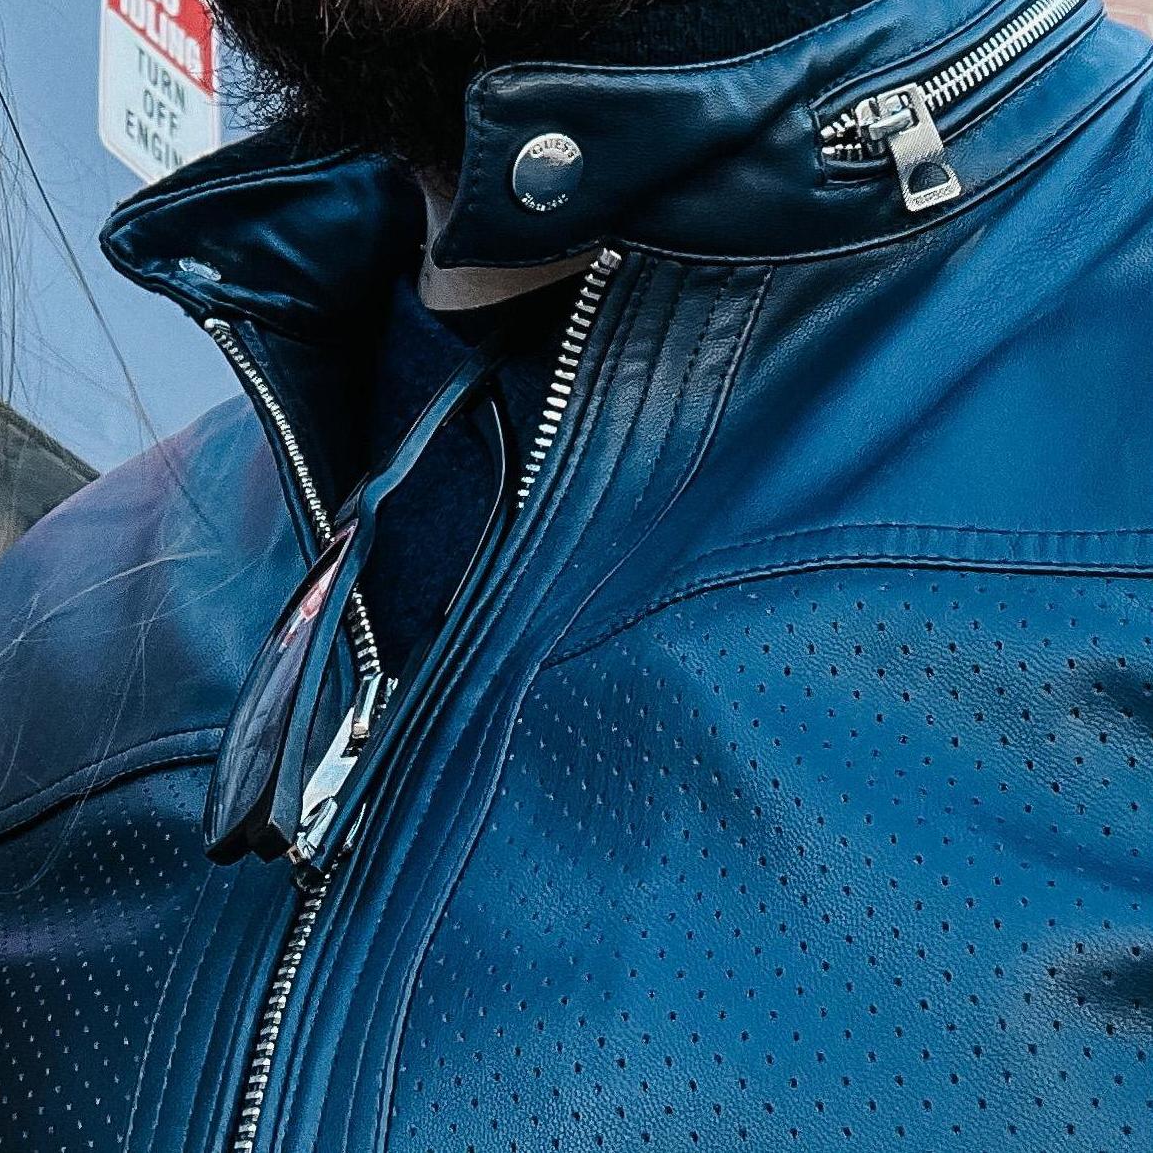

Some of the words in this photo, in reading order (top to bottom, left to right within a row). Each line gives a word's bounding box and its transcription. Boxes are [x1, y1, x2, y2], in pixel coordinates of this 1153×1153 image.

[136, 46, 186, 112] TURN
[126, 110, 184, 169] ENGIN
[143, 88, 178, 137] OFF
